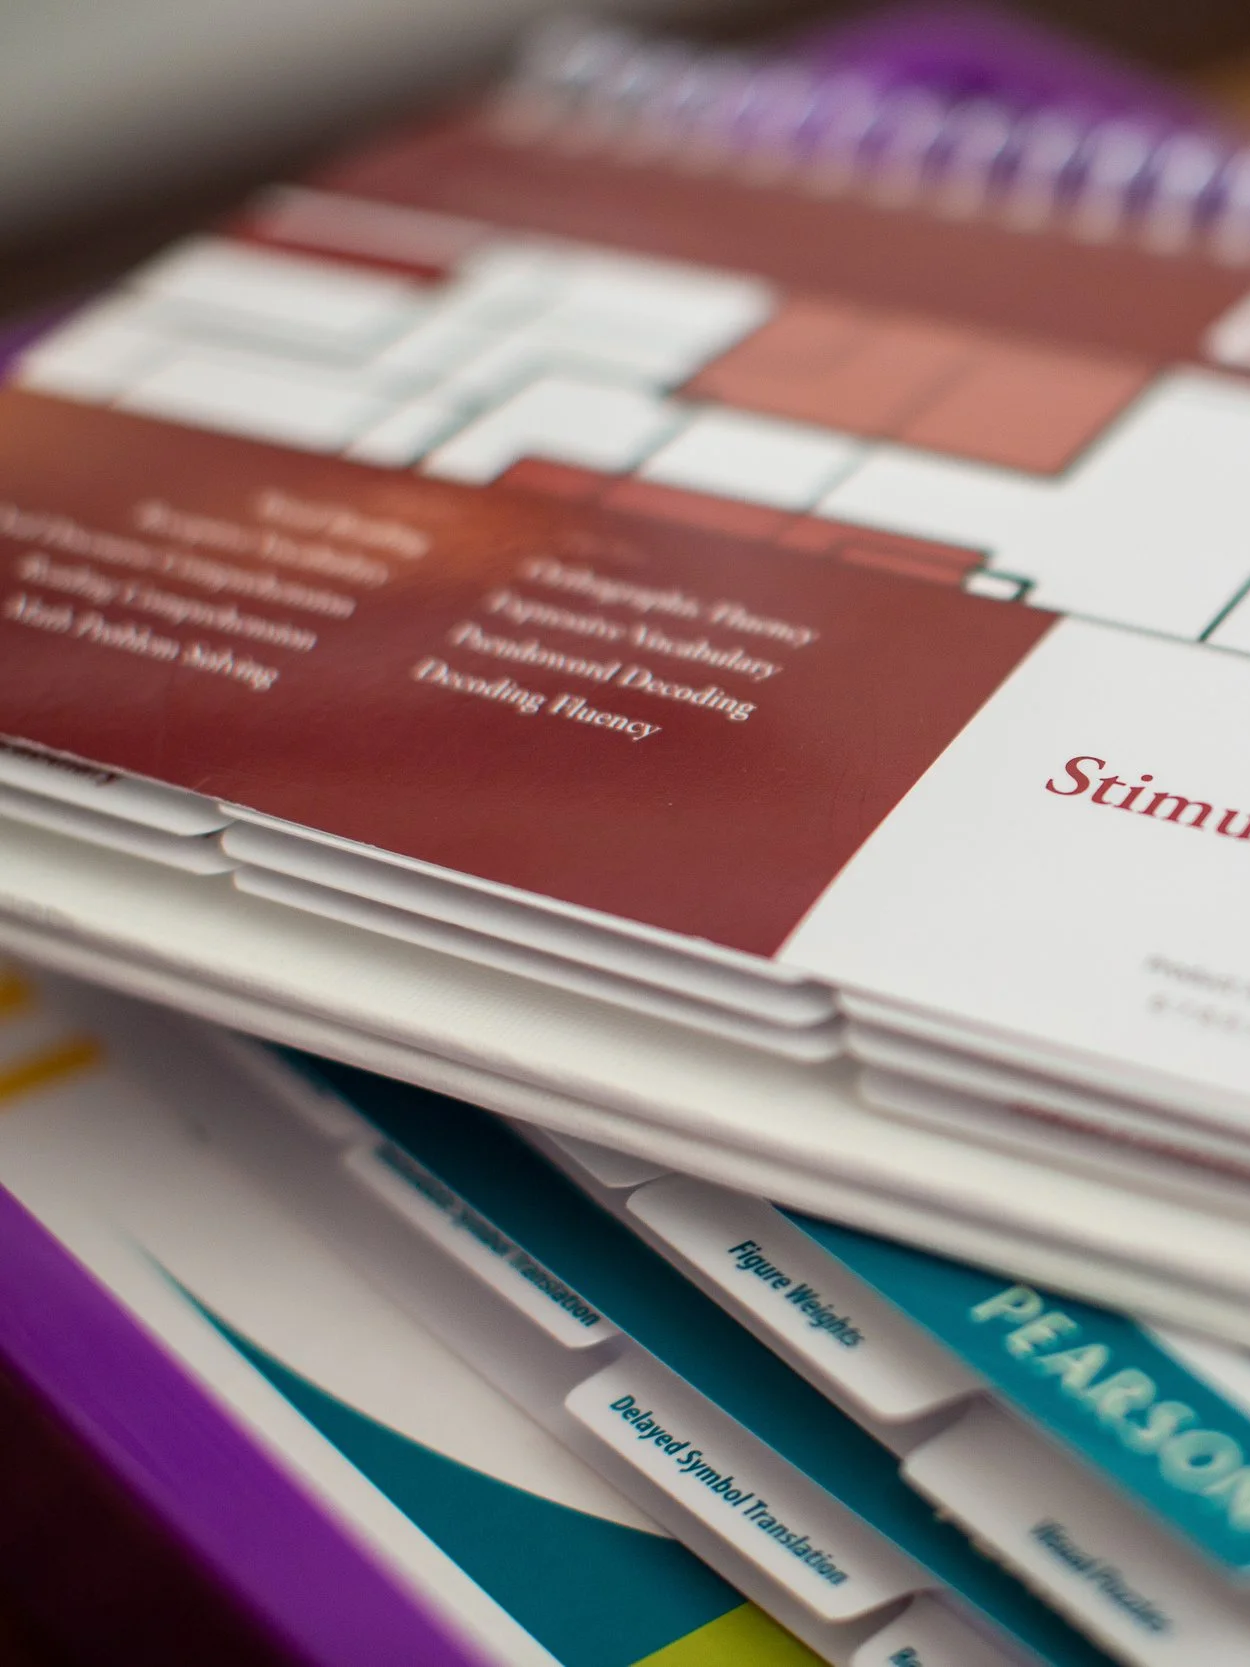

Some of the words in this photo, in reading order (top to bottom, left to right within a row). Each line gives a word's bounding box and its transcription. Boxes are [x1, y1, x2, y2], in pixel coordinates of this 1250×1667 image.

[181, 642, 279, 692] Solving
[451, 622, 621, 684] Pseudoword
[620, 665, 757, 721] Decoding
[490, 590, 626, 641] Expressive
[633, 624, 782, 682] Vocabulary
[709, 603, 818, 648] Fluency
[413, 658, 547, 713] Decoding
[548, 694, 662, 741] Fluency
[728, 1240, 791, 1290] Figure
[785, 1283, 865, 1346] Weights
[609, 1395, 690, 1455] Delayed
[677, 1450, 754, 1507] Symbol
[743, 1499, 849, 1586] Translation
